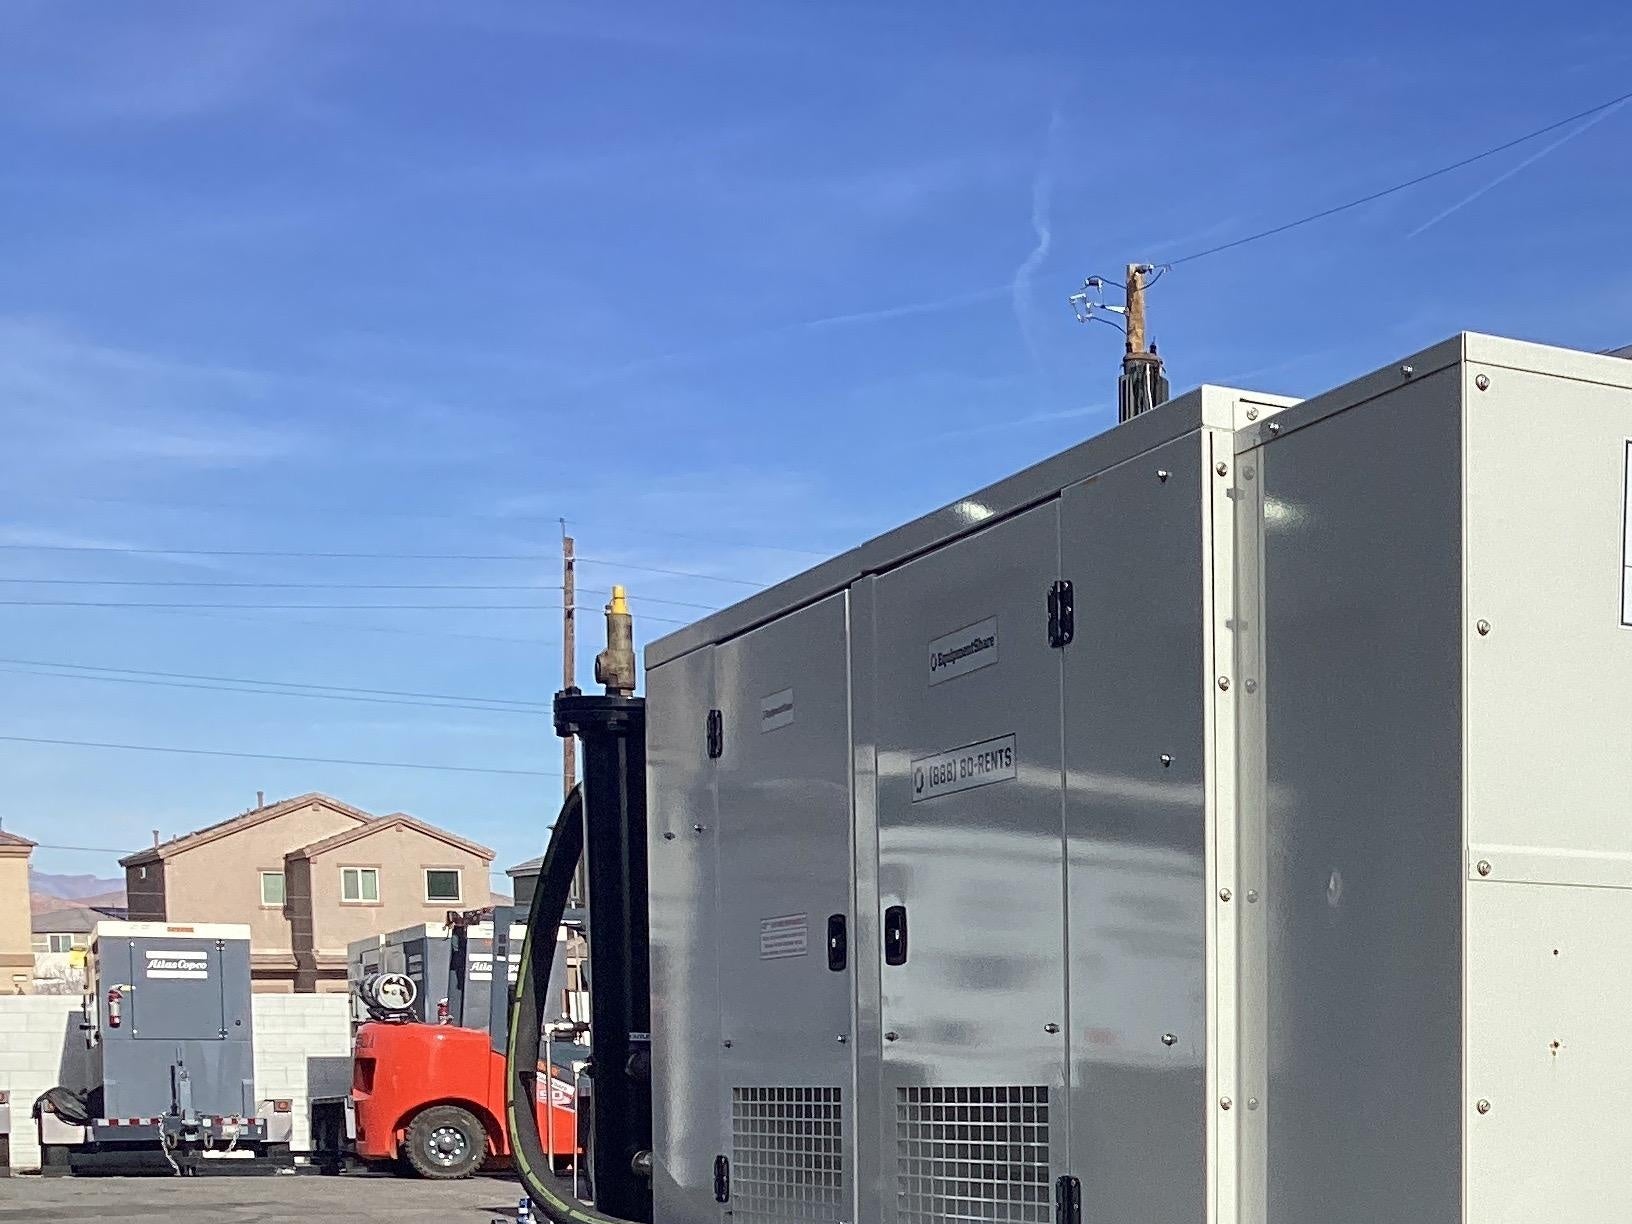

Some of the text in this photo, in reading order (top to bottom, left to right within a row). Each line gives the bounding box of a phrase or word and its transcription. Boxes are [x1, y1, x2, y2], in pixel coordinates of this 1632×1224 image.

[937, 635, 995, 668] EquipmentShare
[929, 747, 1013, 788] (888) 80-RENTS
